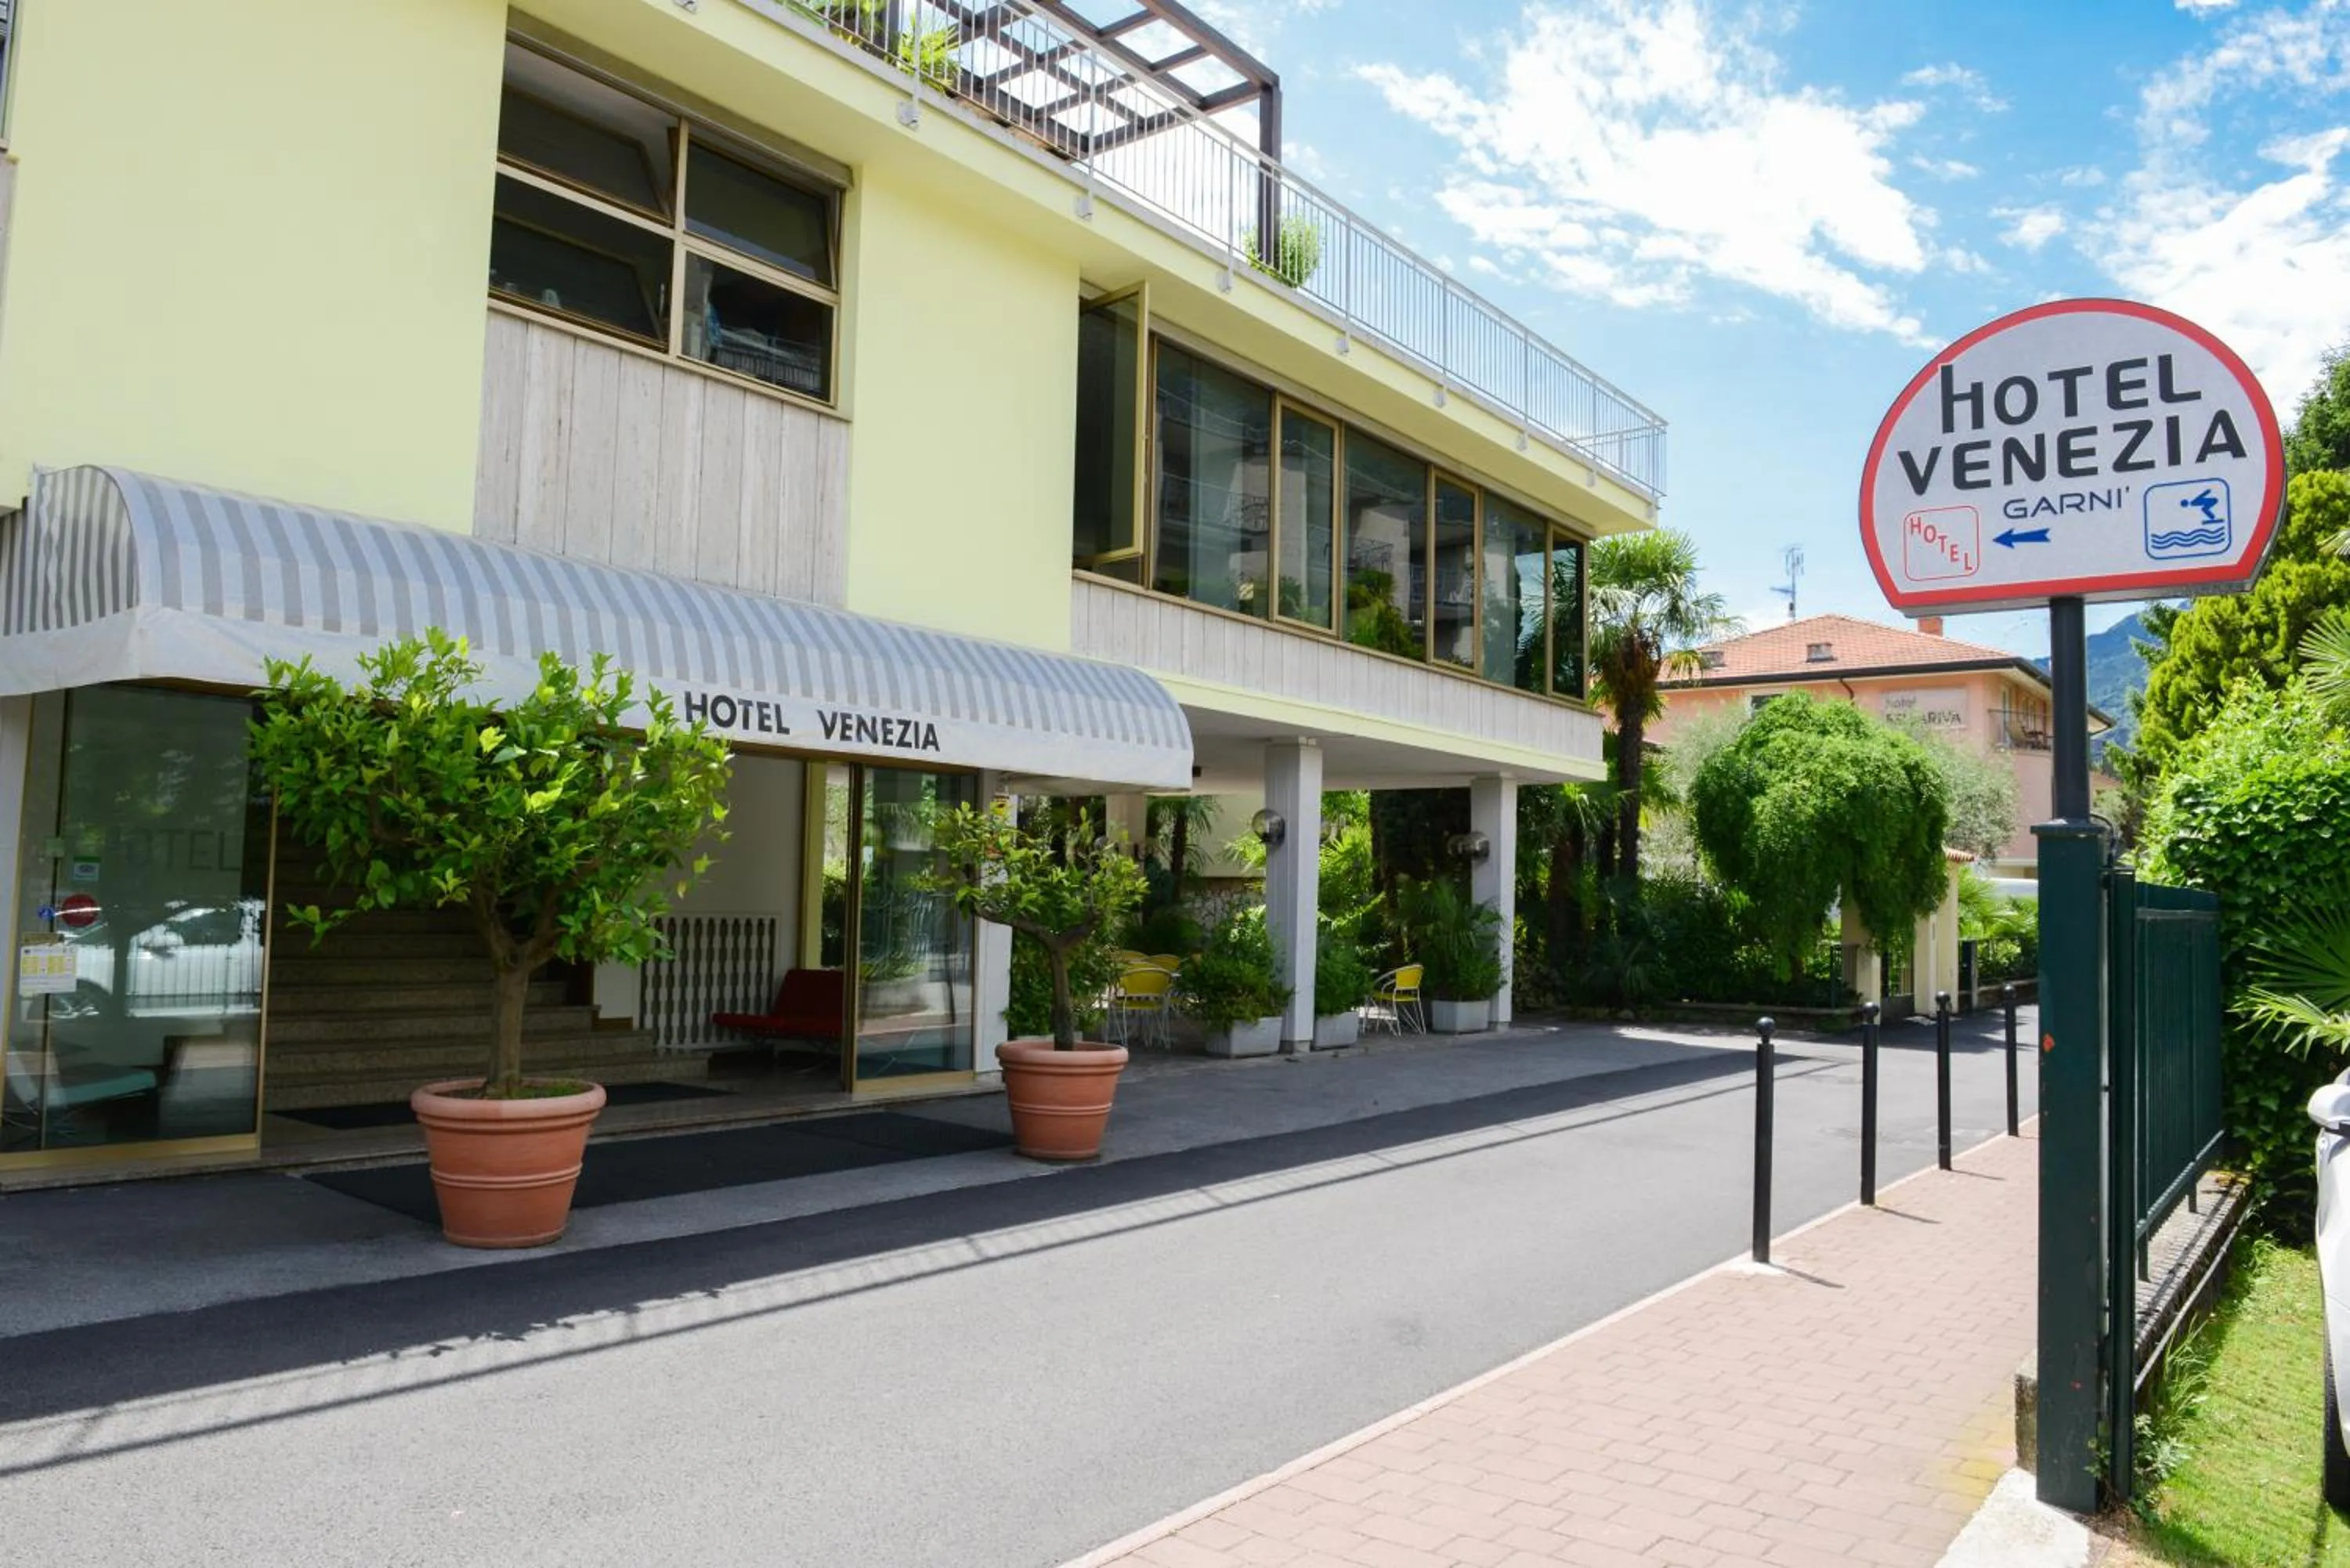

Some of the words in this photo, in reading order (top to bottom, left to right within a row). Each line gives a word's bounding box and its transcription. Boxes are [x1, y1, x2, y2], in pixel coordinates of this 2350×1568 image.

[1940, 354, 2202, 434] HOTEL
[1898, 409, 2247, 496] VENEZIA
[2003, 486, 2131, 518] GARNI'
[1909, 517, 1973, 572] HOTEL
[685, 691, 790, 735] HOTEL
[817, 710, 940, 752] VENEZIA
